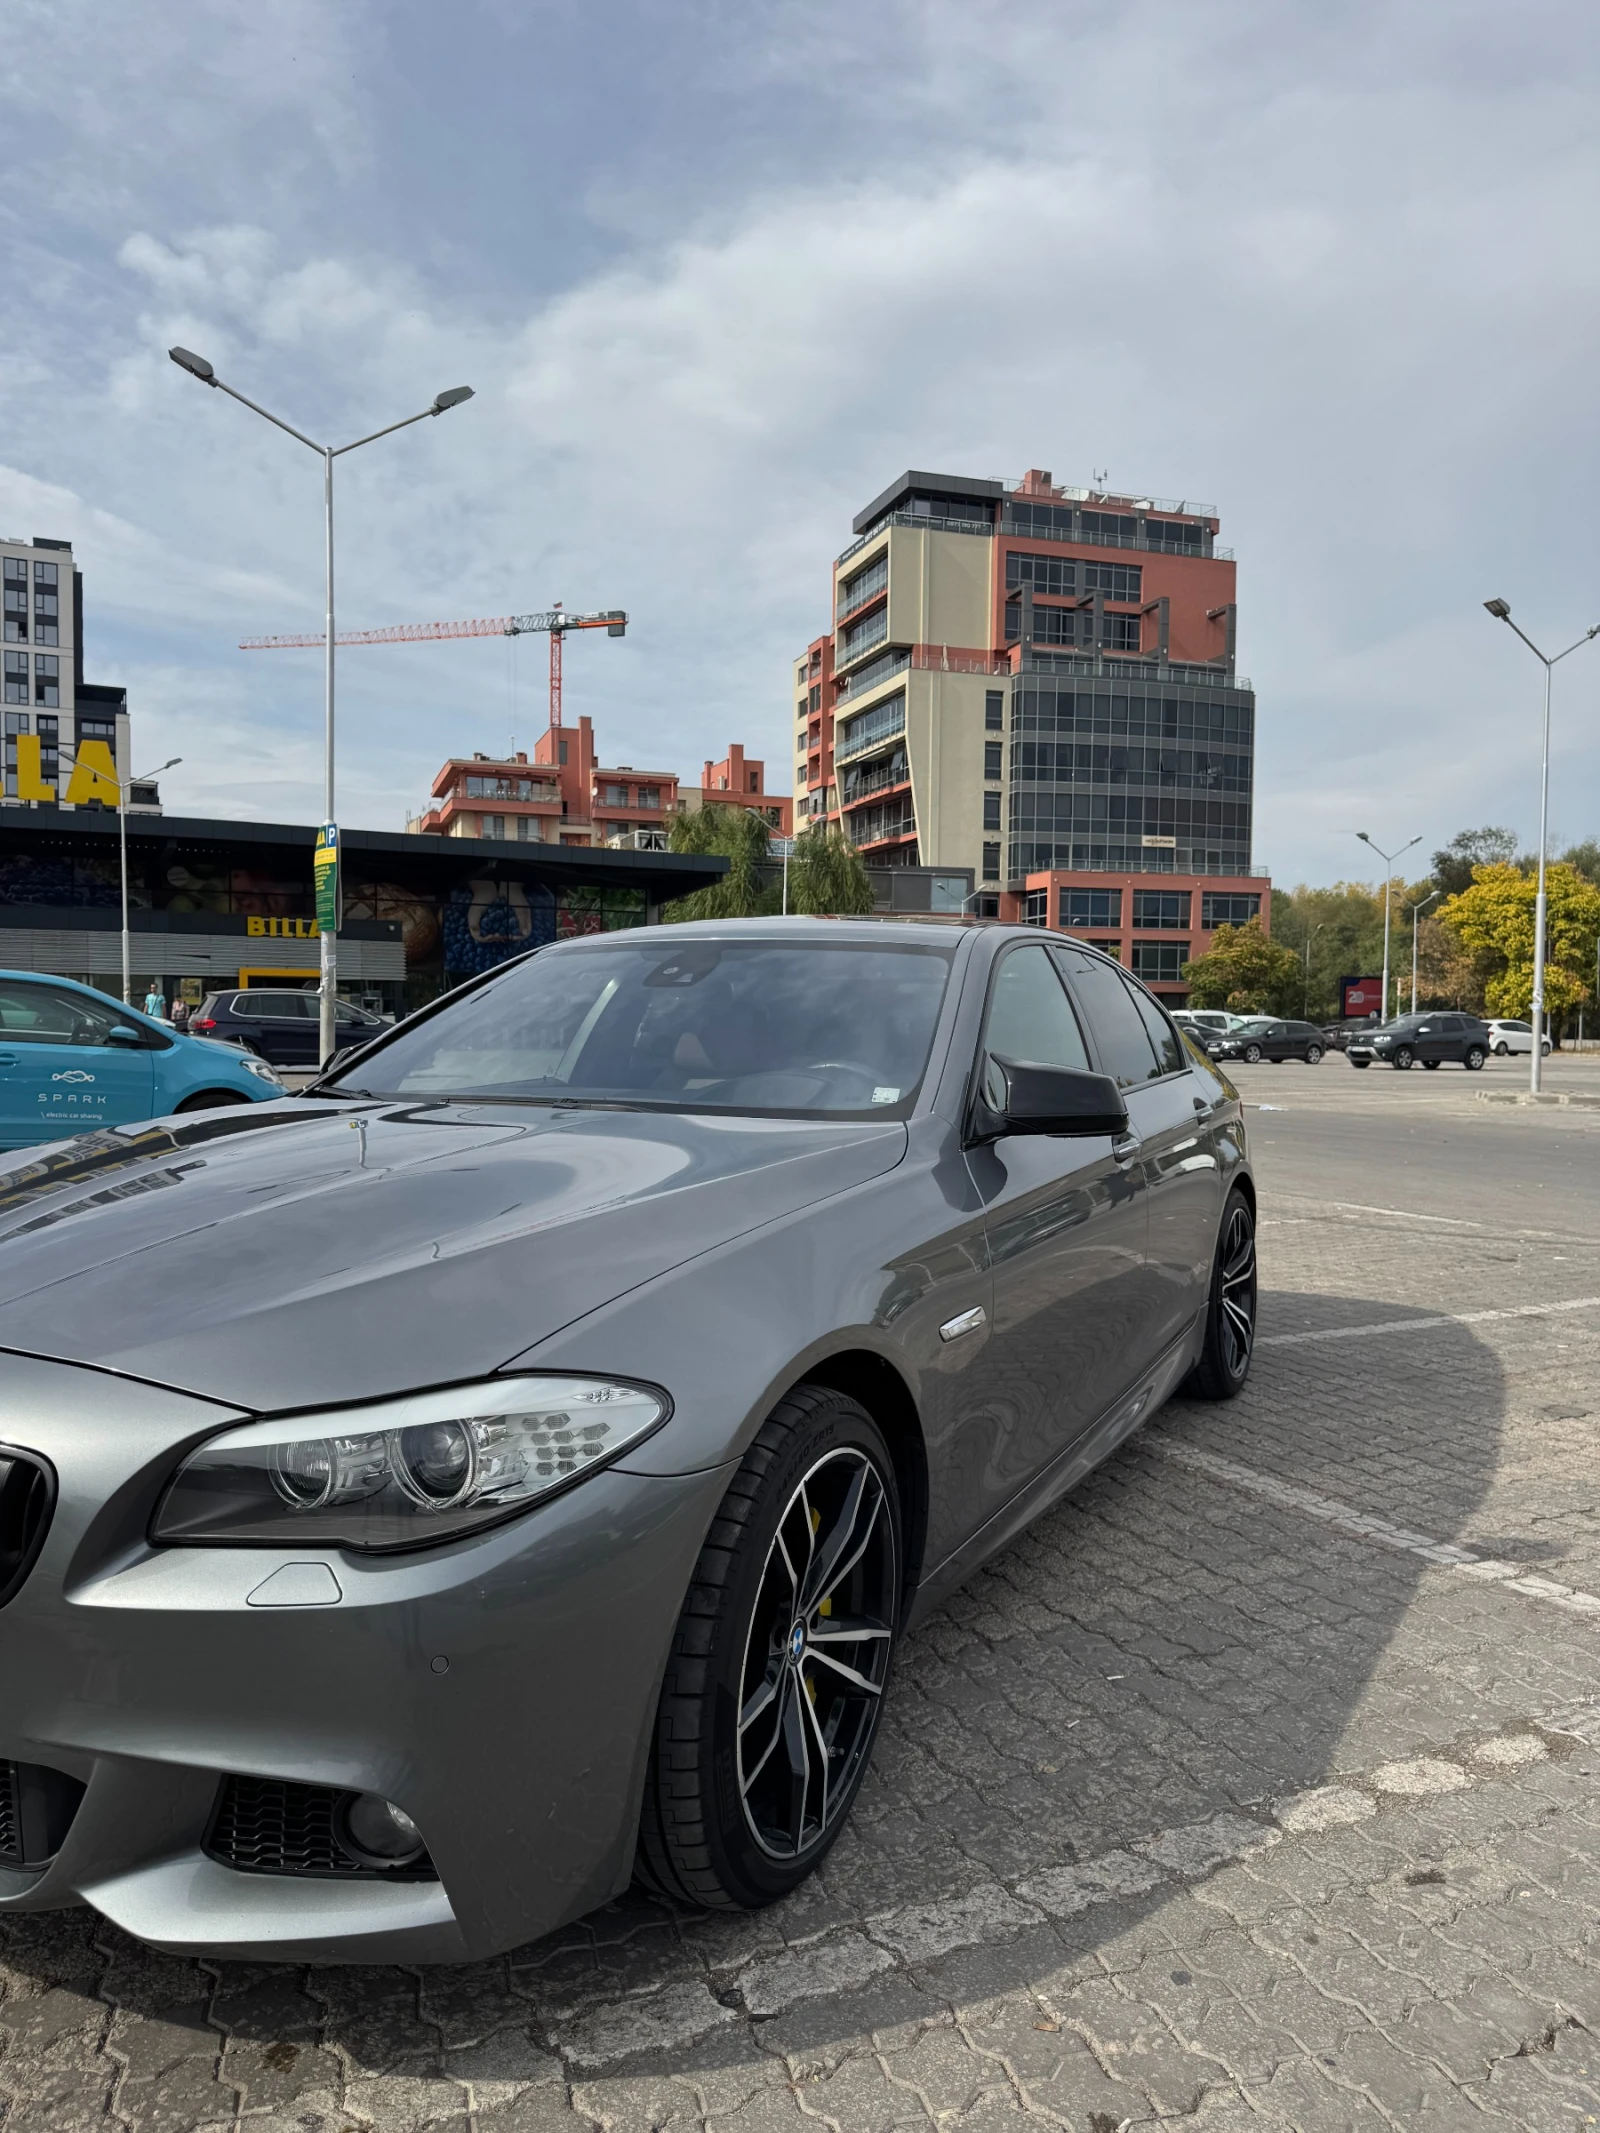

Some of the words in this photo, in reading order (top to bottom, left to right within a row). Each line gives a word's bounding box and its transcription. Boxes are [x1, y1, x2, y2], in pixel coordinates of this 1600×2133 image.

[0, 734, 121, 806] LA
[328, 827, 335, 844] P
[247, 916, 321, 938] BILLA
[38, 1093, 106, 1104] SPARK
[80, 1112, 102, 1120] sharing
